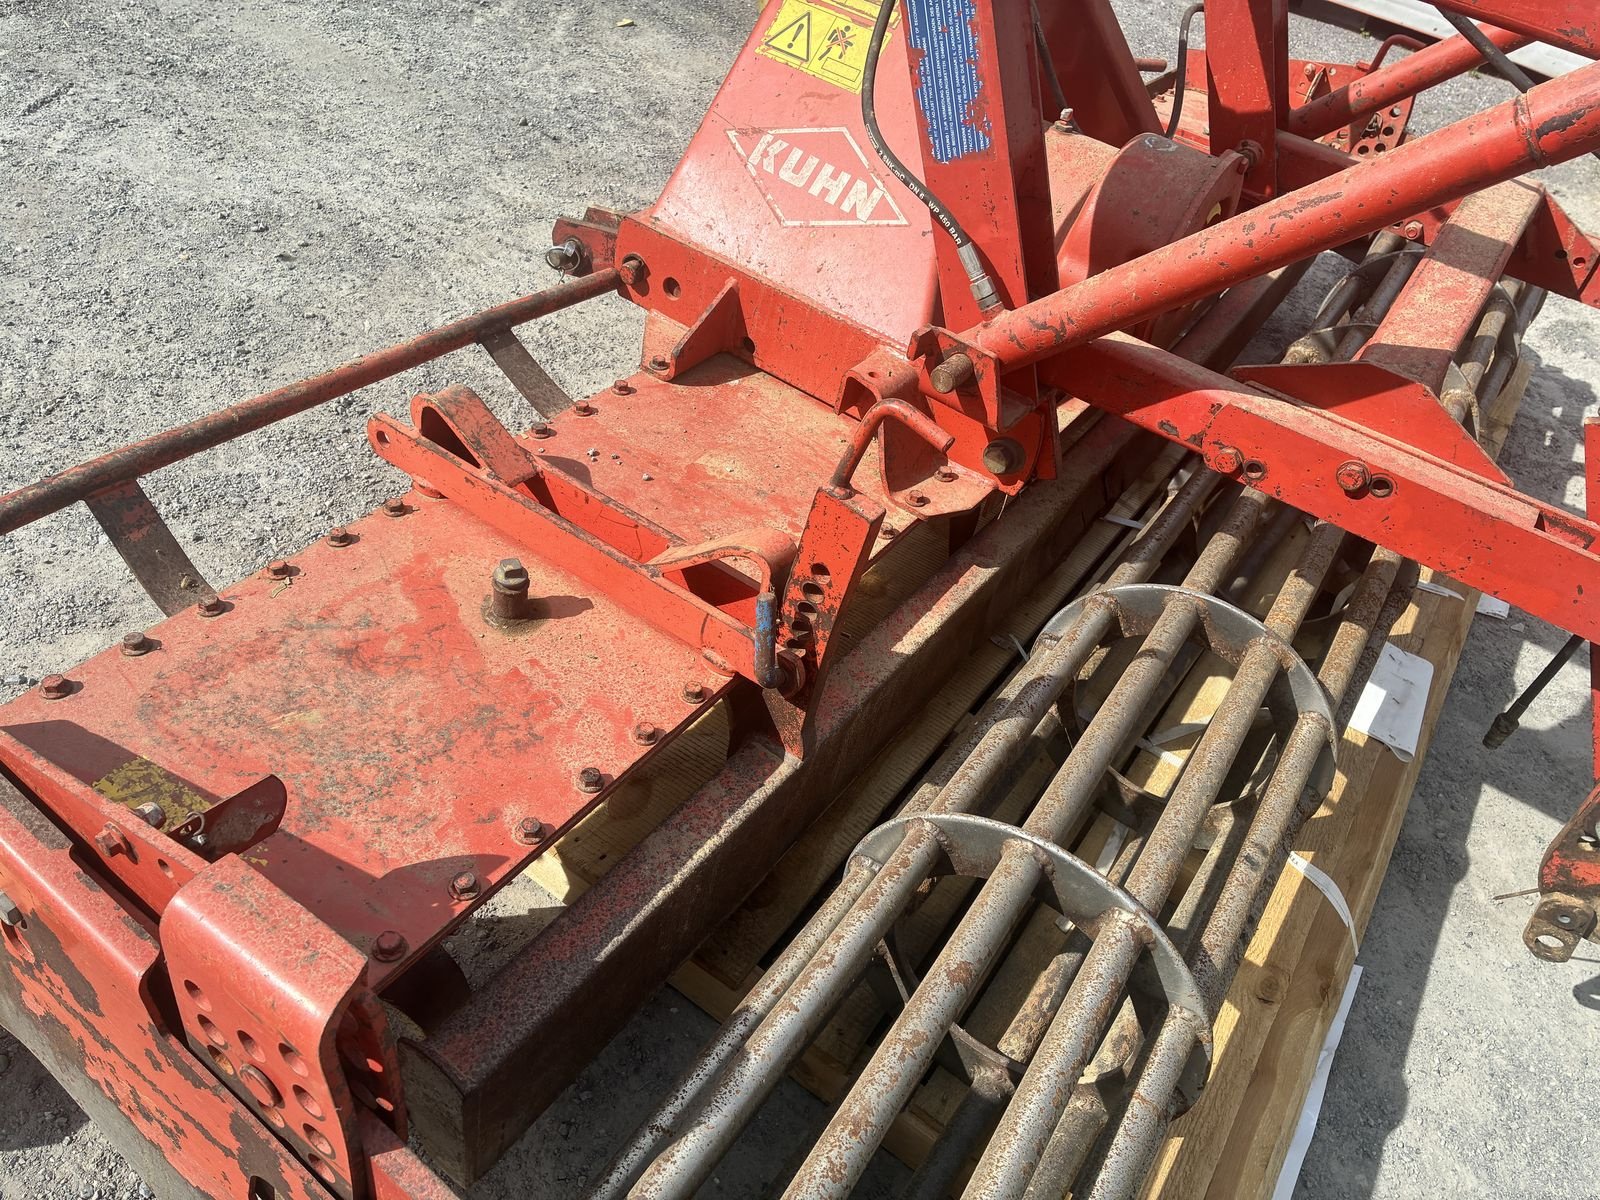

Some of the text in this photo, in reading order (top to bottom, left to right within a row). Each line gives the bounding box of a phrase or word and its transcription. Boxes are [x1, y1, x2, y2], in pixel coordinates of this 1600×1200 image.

[748, 134, 884, 222] KUHN
[908, 182, 920, 195] DN
[927, 200, 940, 213] WP
[938, 214, 951, 228] 450
[948, 227, 962, 245] BAR
